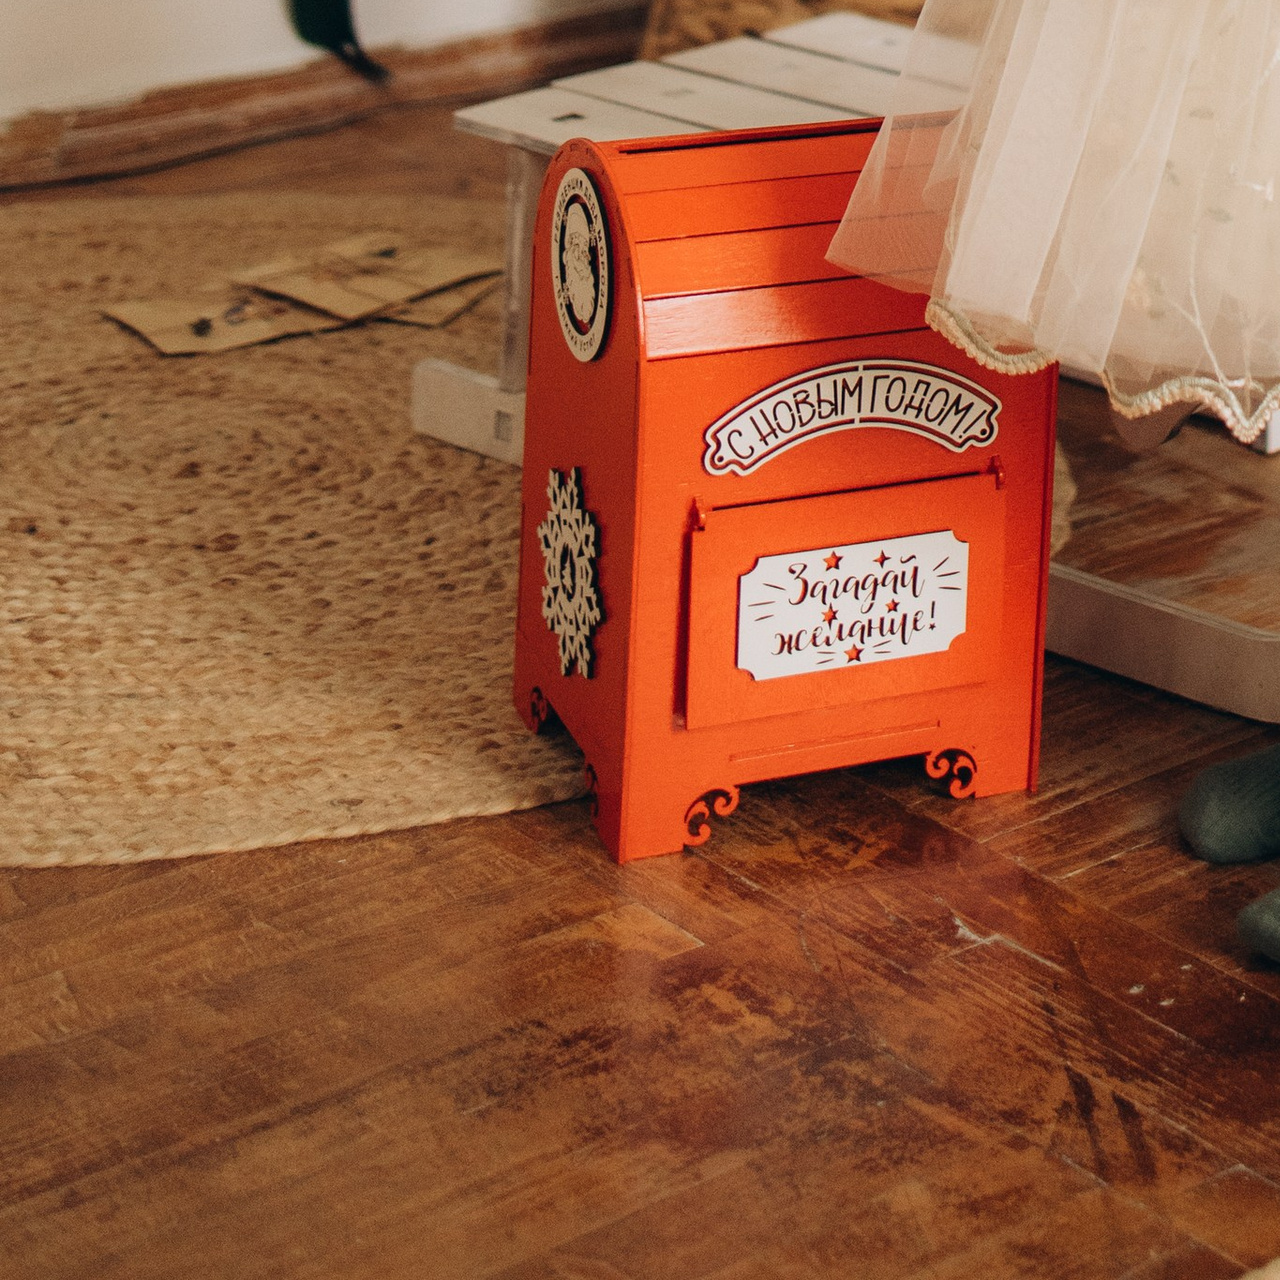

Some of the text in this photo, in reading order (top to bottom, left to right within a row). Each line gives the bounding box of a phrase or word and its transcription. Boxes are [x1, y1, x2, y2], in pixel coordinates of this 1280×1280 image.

[727, 374, 987, 459] С НОВЫМ ГОДОМ!
[788, 554, 925, 614] Загадай
[771, 600, 936, 656] желание!
